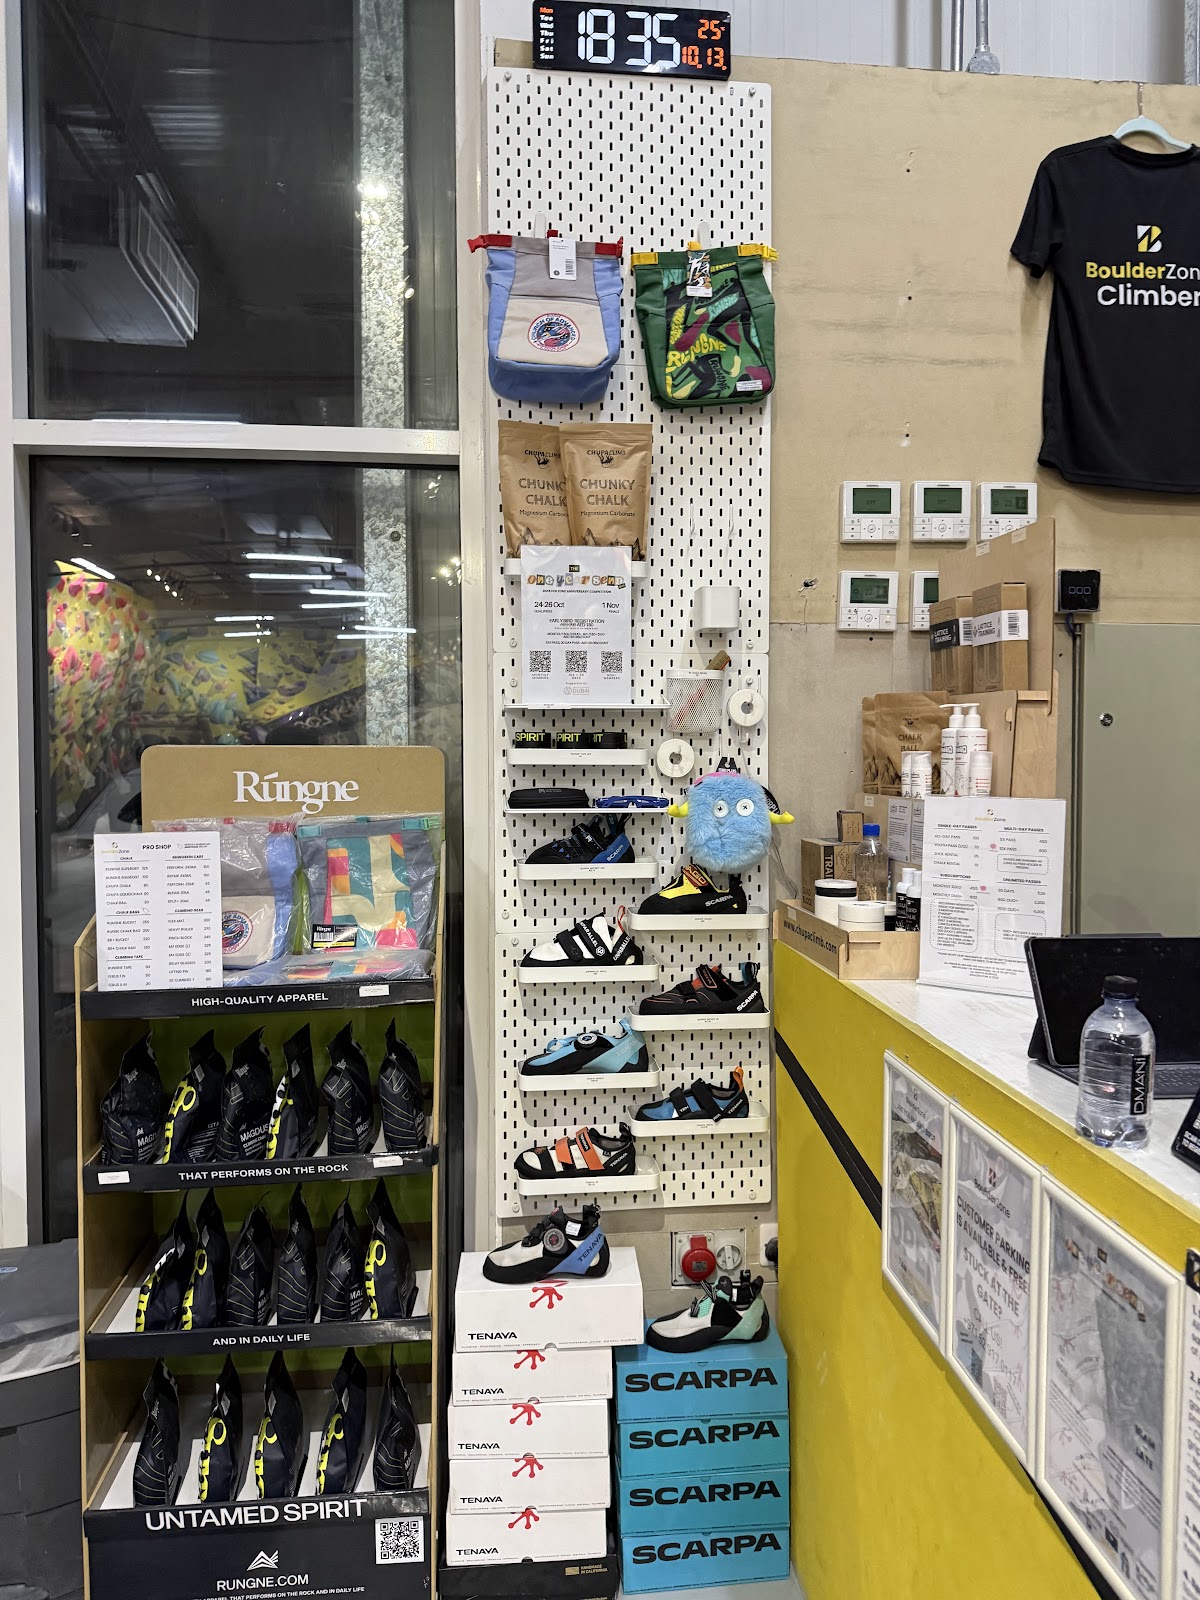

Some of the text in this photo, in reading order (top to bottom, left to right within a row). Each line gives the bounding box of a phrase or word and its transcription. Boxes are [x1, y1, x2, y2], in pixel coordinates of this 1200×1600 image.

[578, 9, 681, 68] 18 35
[1086, 261, 1200, 281] BoulderZon
[519, 478, 566, 492] CHUNK
[580, 479, 635, 490] CHUNKY
[586, 494, 629, 507] CHALK
[520, 509, 548, 518] Magnesium
[580, 510, 636, 518] Magnesium Carbonate
[934, 628, 949, 637] LATTICE
[977, 621, 993, 630] LATTICE
[977, 628, 996, 637] TRAINING
[934, 634, 952, 644] TRAINING
[516, 733, 545, 742] SPIRIT
[556, 733, 581, 743] PIRIT
[898, 734, 922, 742] CHALK
[900, 744, 919, 752] BALL
[233, 770, 360, 815] Rúngne
[824, 855, 834, 880] TRAI
[704, 895, 734, 907] SCARPA
[783, 920, 838, 955] www.chupaclimb.com
[191, 992, 329, 1007] HIGH-QUALITY APPAREL
[736, 990, 759, 1012] SCARPA
[239, 1122, 270, 1143] MAGDUS
[609, 1152, 629, 1168] TENAYA
[178, 1163, 349, 1181] THAT PERFORMS ON THE ROCK
[957, 1195, 1031, 1275] CUSTOMER PARKING
[577, 1233, 603, 1263] TENAYA
[963, 1223, 1001, 1267] AVAILABLE
[1001, 1259, 1008, 1271] &
[963, 1252, 1020, 1318] STUCK AT THE
[977, 1284, 1003, 1320] GATE?
[212, 1333, 311, 1346] AND IN DAILY LIFE
[467, 1331, 518, 1341] TENAYA
[625, 1367, 778, 1393] SCARPA
[461, 1387, 505, 1396] TENAYA
[629, 1420, 780, 1450] SCARPA
[460, 1496, 503, 1504] TENAYA
[629, 1480, 781, 1507] SCARPA
[145, 1498, 369, 1531] UNTAMED SPIRIT
[456, 1547, 499, 1556] TENAYA
[632, 1533, 782, 1565] SCARPA
[216, 1573, 310, 1592] RUNGNE.COM
[246, 1592, 277, 1600] PERFORMS
